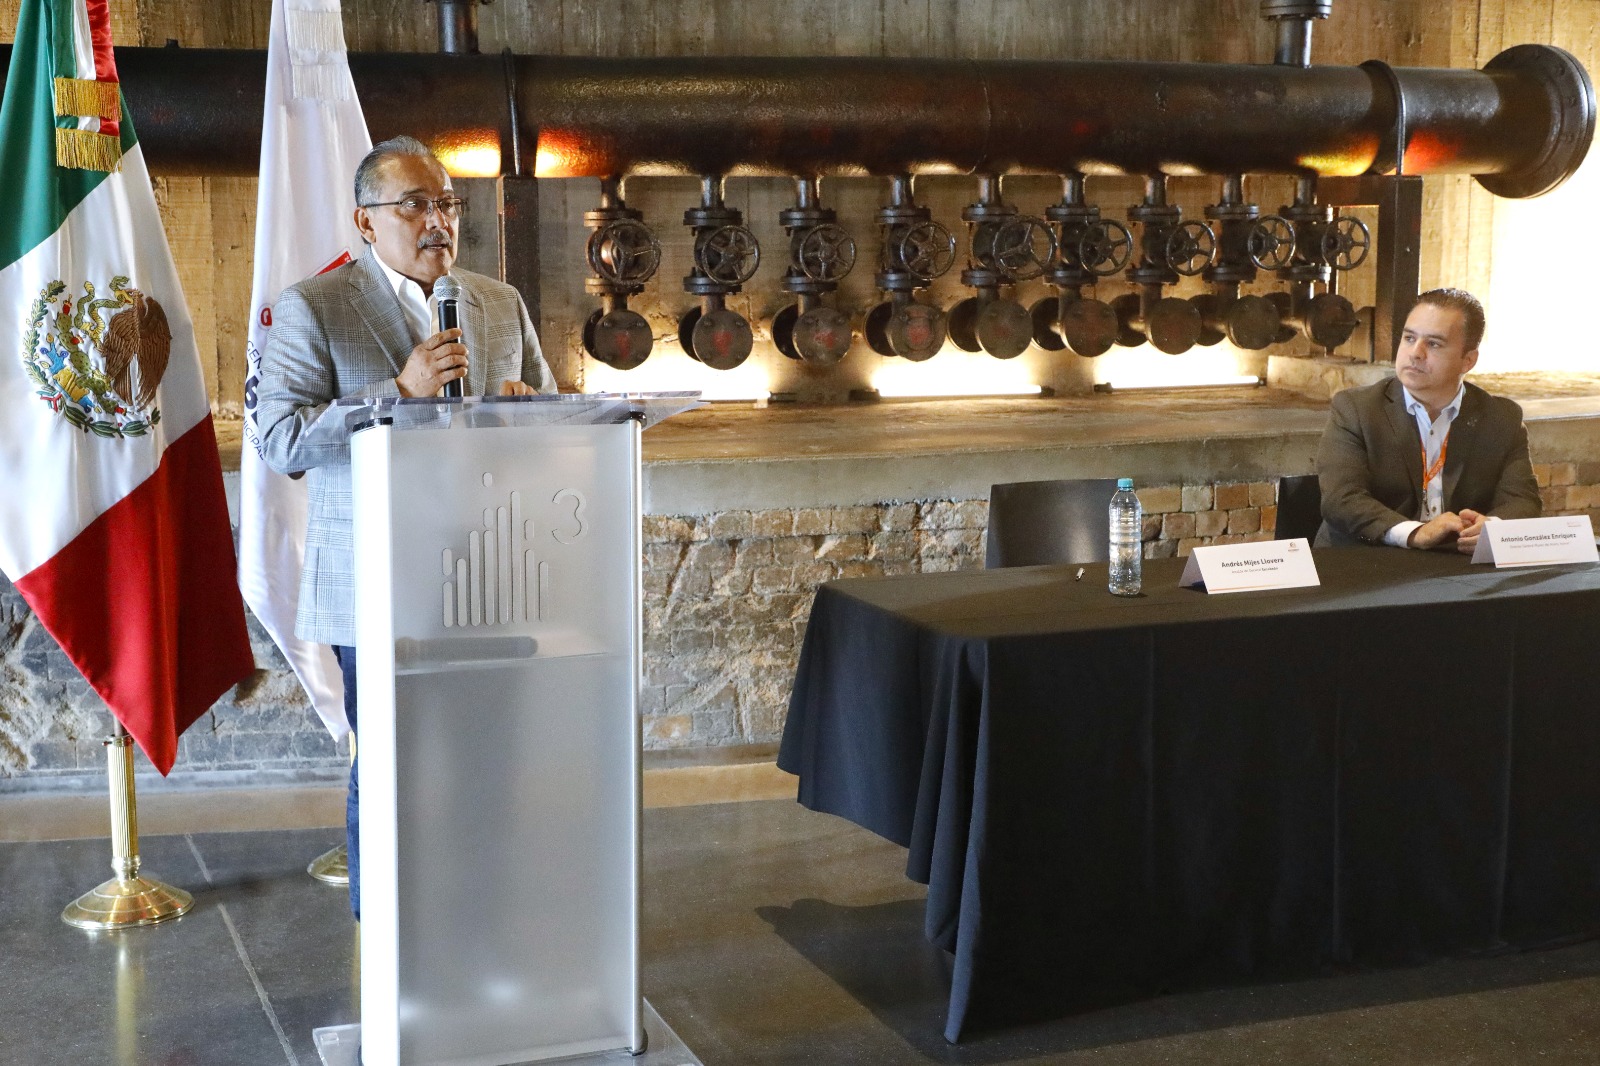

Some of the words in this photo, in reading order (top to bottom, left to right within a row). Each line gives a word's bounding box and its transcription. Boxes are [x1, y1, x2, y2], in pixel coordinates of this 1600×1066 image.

[552, 488, 589, 545] 3
[1500, 535, 1524, 543] Antonio
[1244, 559, 1260, 567] Mijes
